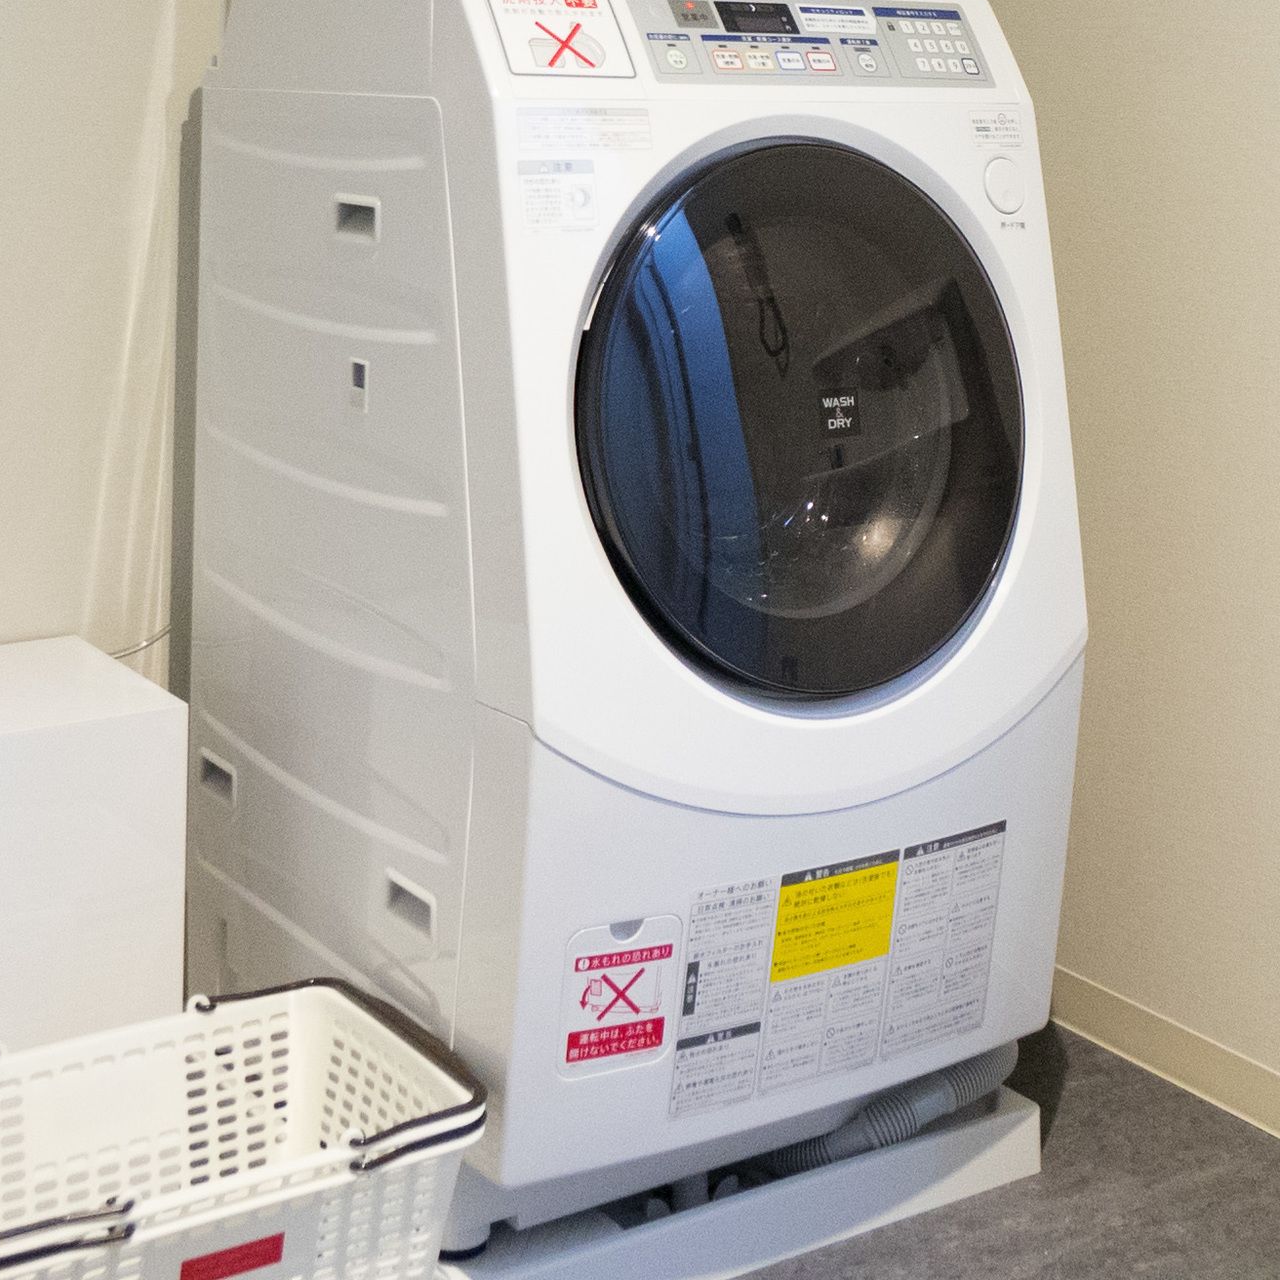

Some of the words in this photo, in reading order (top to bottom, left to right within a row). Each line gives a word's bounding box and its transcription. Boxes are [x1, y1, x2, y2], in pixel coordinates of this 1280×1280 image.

[822, 396, 855, 408] WASH
[828, 417, 853, 429] DRY
[591, 946, 671, 968] 水もれの恐れあり
[578, 1023, 654, 1046] 運転中は、ふたを
[568, 1034, 660, 1061] 開けないでください。
